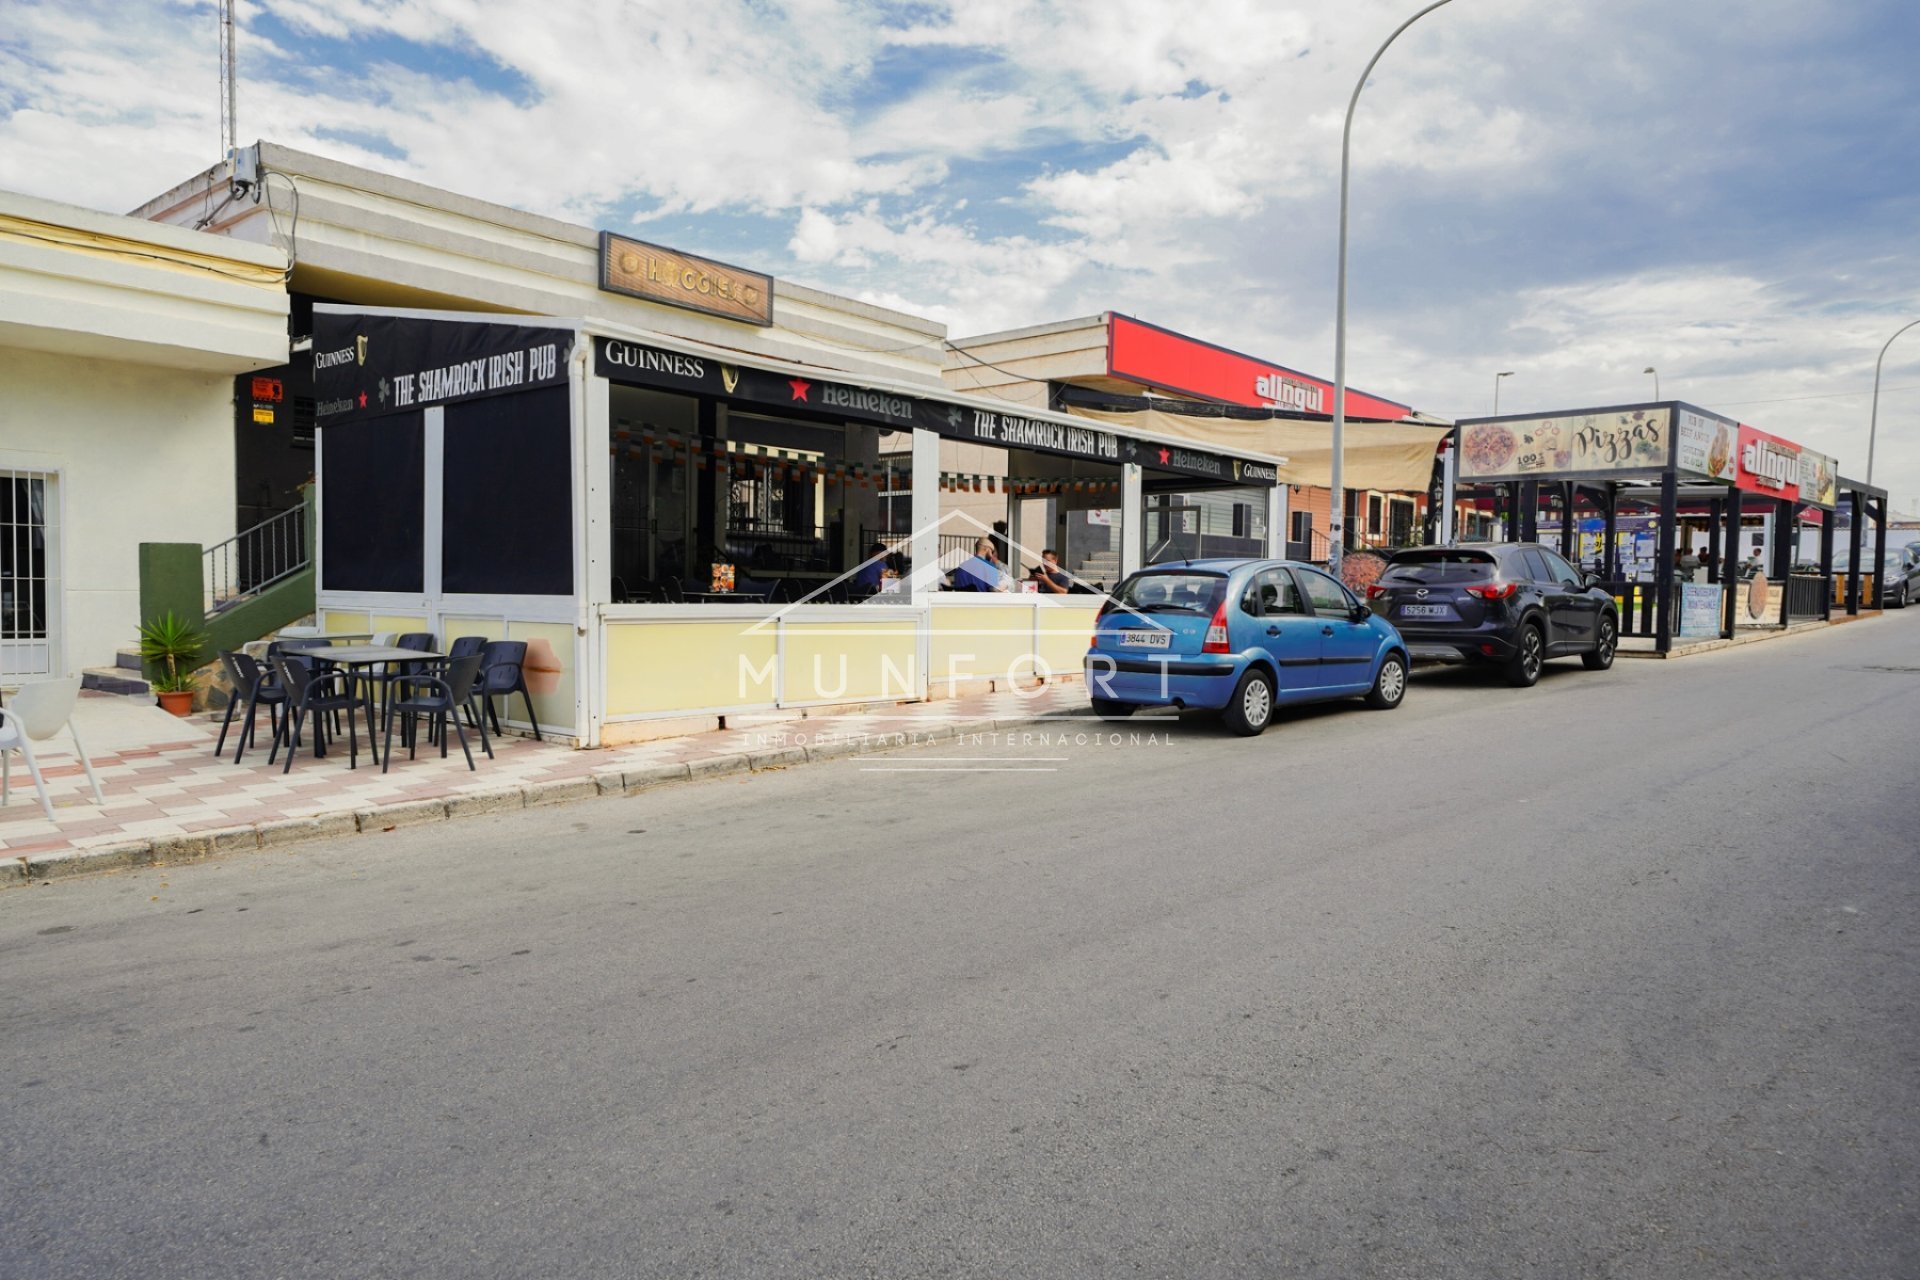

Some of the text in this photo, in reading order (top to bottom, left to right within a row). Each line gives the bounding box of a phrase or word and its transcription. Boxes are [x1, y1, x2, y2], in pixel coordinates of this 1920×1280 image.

[315, 346, 354, 369] GUINNESS
[605, 340, 704, 379] GUINNESS
[393, 343, 557, 407] THE SHAMROCK IRISH PUB
[316, 397, 354, 417] Heineken
[822, 384, 913, 420] Heineken
[973, 410, 1118, 458] THE SHAMROCK IRISH PUB
[1571, 418, 1663, 464] Pizzas
[1172, 451, 1221, 475] Heineken
[1243, 463, 1276, 480] GUINNESS
[1126, 634, 1167, 645] 3844 DVS
